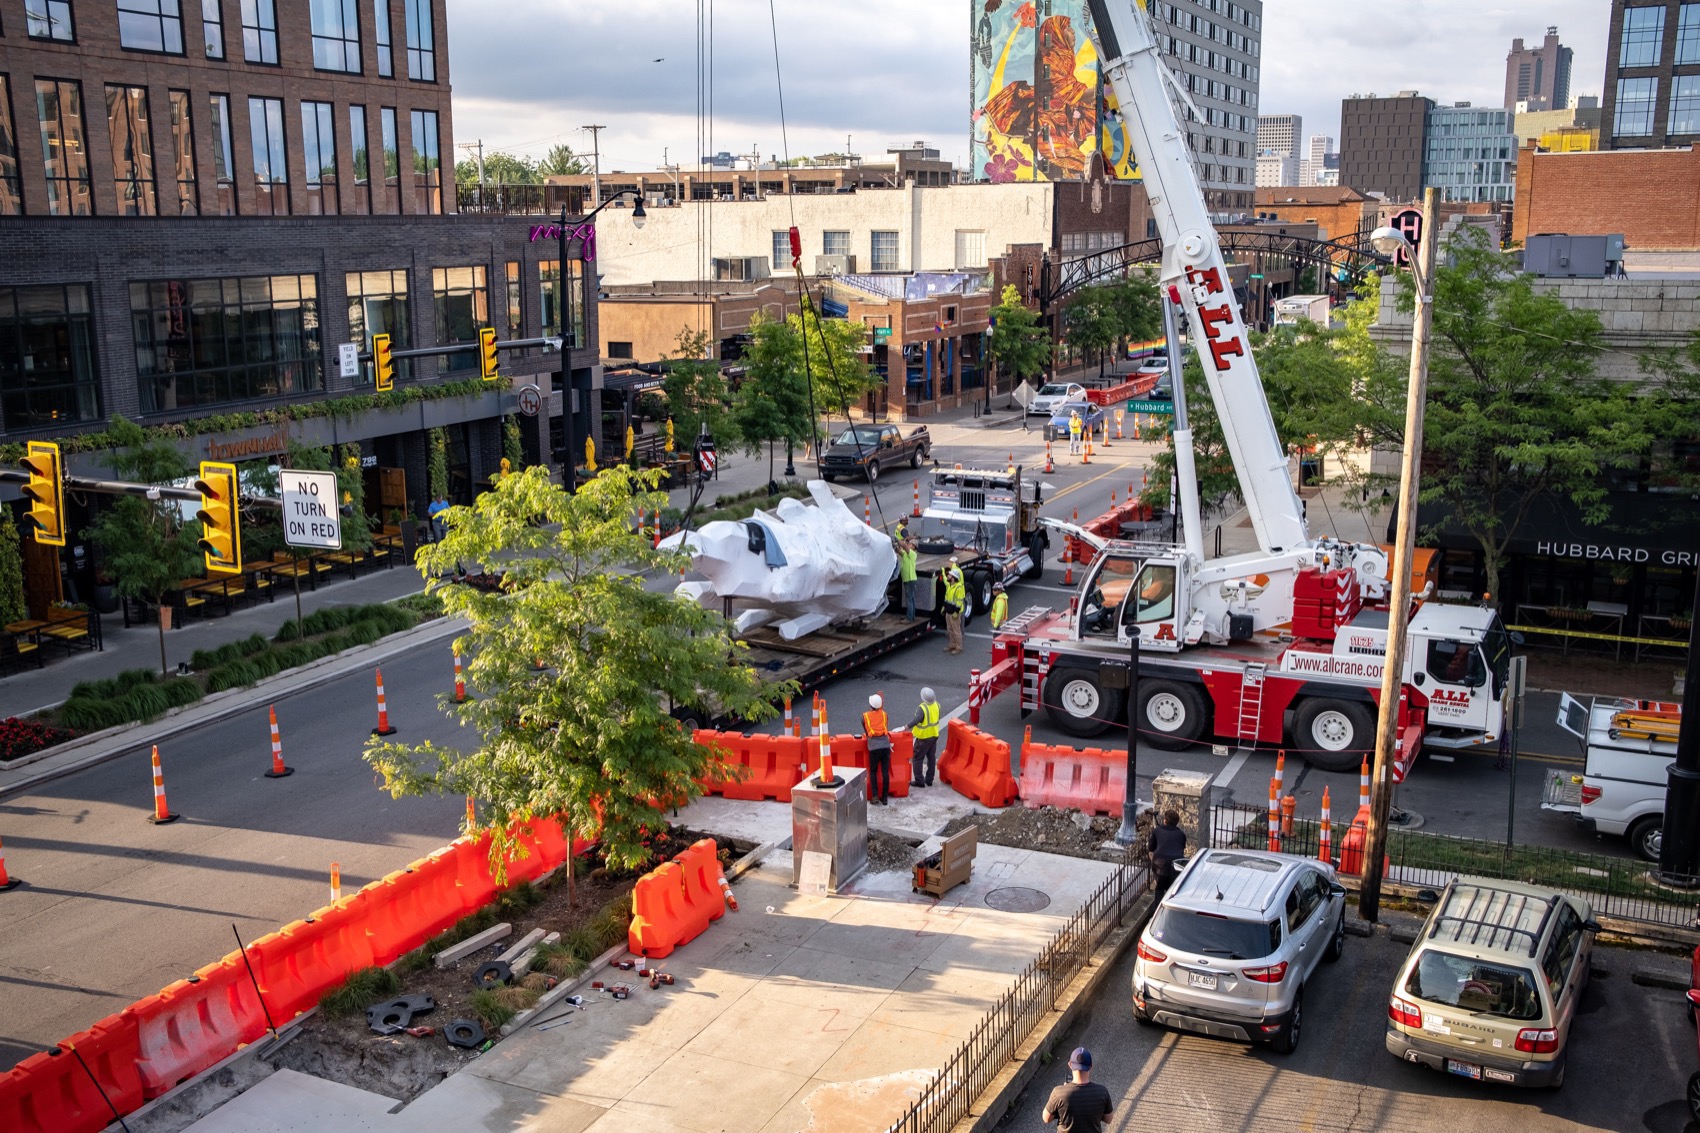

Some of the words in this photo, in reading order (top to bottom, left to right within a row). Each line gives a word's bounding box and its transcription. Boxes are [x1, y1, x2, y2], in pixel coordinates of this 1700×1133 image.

[1185, 265, 1244, 371] ALL
[1135, 402, 1165, 411] Hubbard
[298, 481, 319, 496] NO
[294, 501, 327, 517] TURN
[289, 521, 306, 536] ON
[311, 522, 335, 538] RED
[1537, 541, 1649, 562] HUBBARD
[1154, 623, 1177, 640] A
[1431, 689, 1470, 703] ALL
